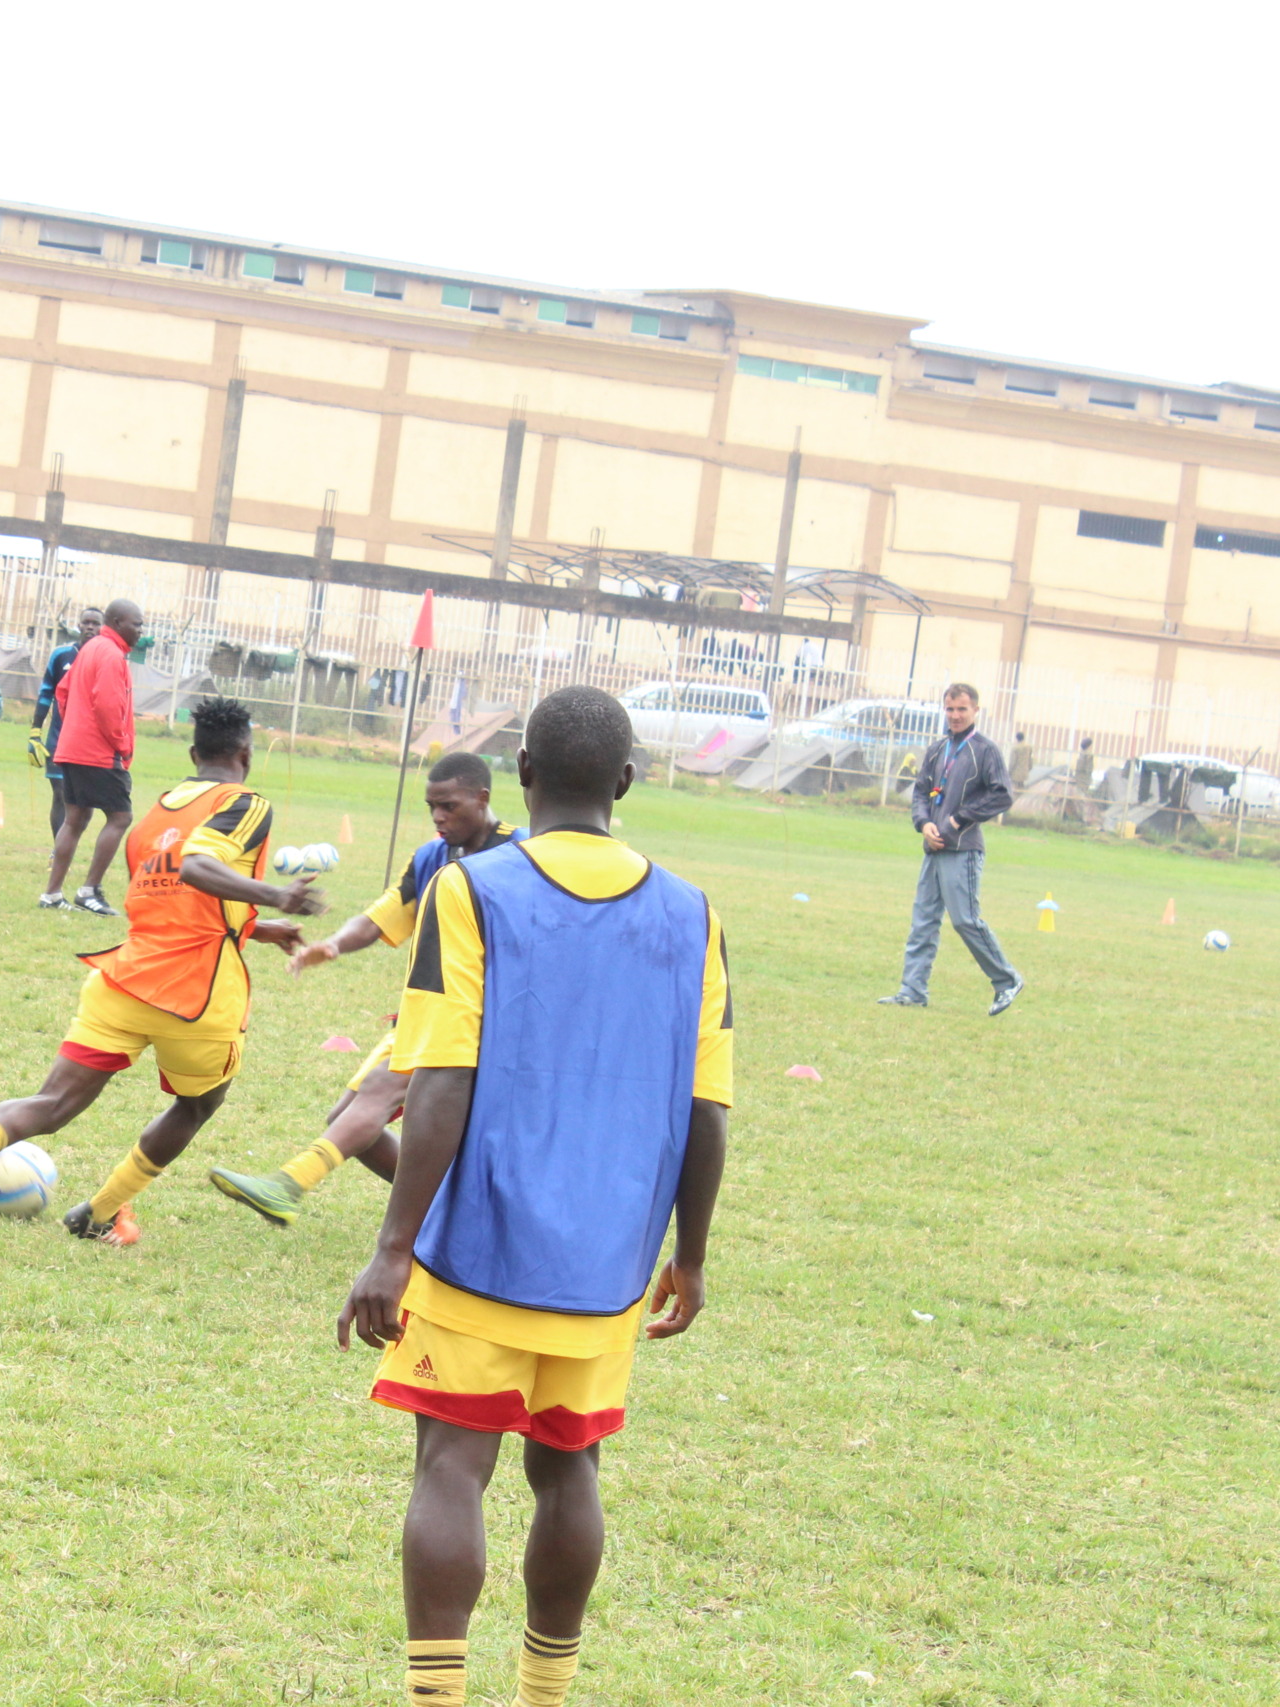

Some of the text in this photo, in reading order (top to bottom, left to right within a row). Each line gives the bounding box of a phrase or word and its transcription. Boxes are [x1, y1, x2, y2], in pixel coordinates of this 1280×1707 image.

[141, 852, 180, 875] NIL
[136, 878, 184, 889] SPECIA
[413, 1369, 438, 1382] adidas
